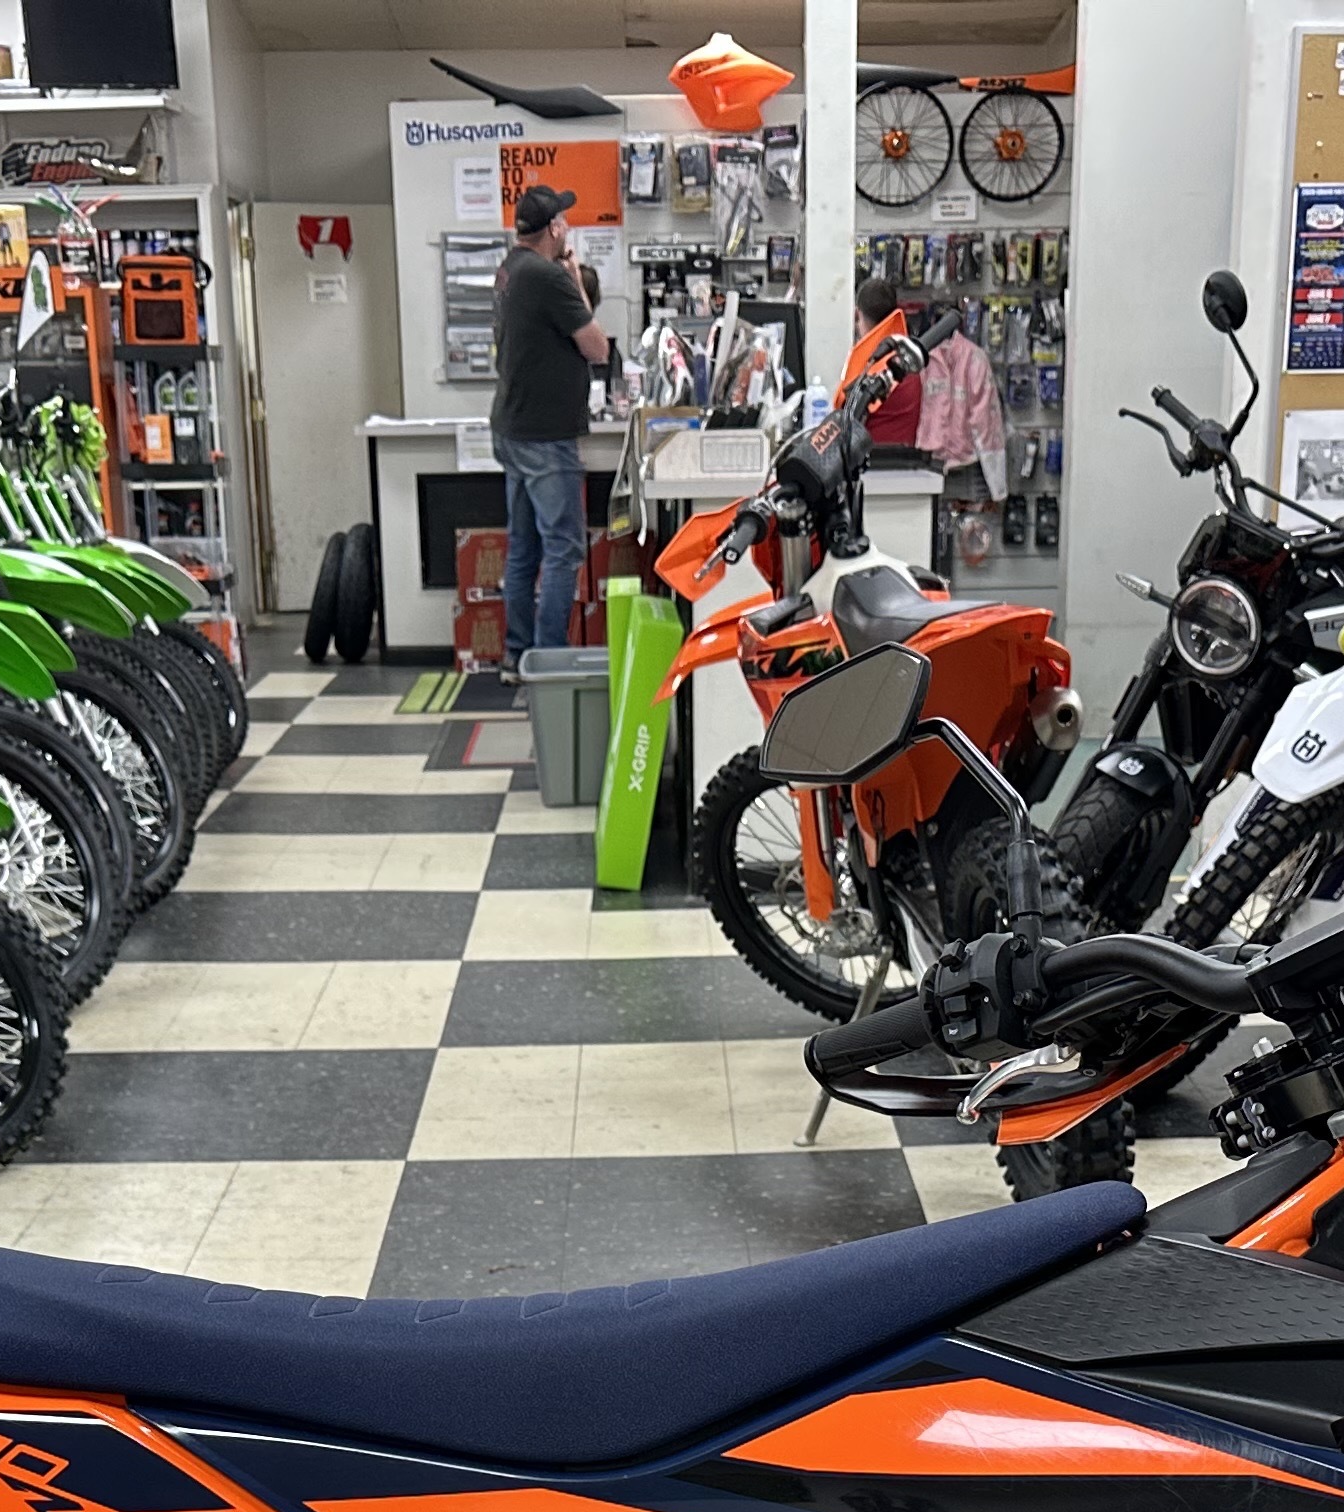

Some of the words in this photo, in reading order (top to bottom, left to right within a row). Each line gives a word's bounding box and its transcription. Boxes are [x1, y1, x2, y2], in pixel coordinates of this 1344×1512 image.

[426, 121, 525, 144] Husqvarna
[500, 146, 559, 168] READY
[501, 167, 524, 187] TO
[501, 187, 527, 206] RA
[811, 421, 841, 453] KTM
